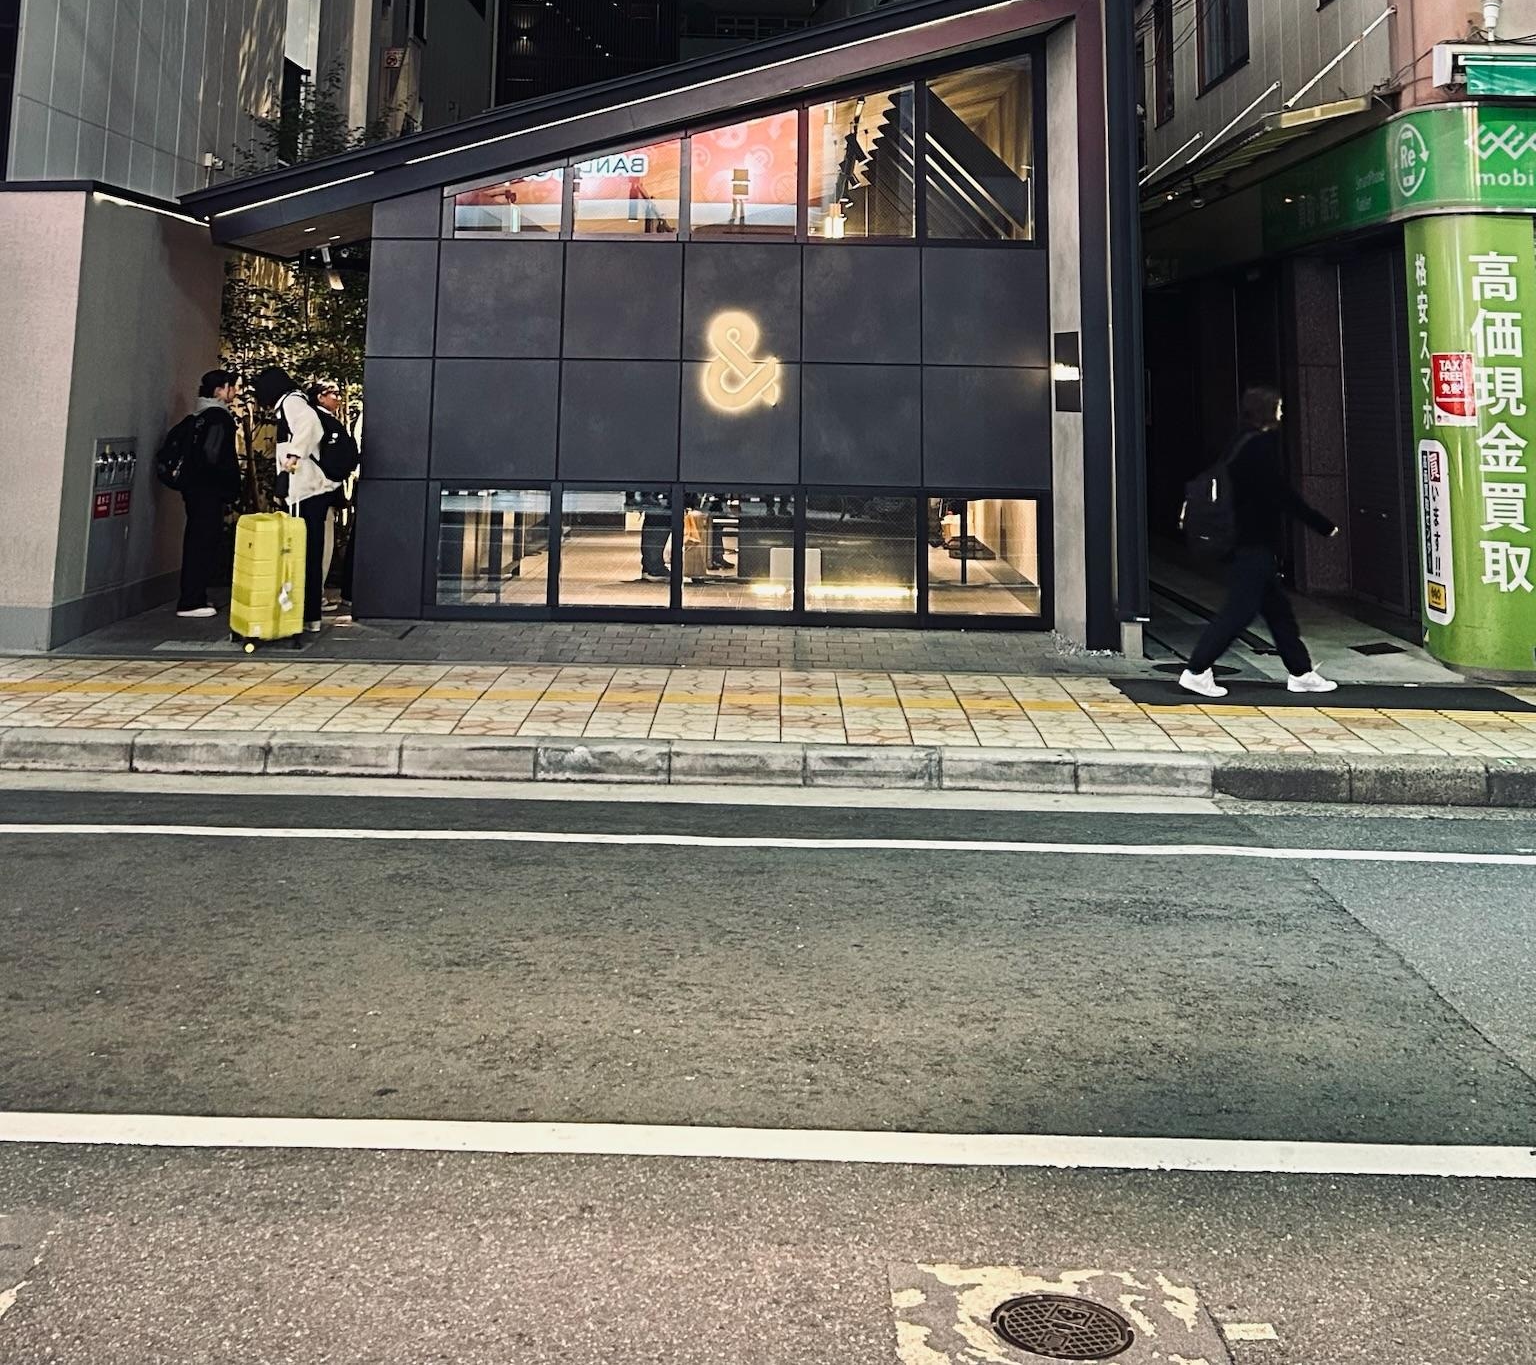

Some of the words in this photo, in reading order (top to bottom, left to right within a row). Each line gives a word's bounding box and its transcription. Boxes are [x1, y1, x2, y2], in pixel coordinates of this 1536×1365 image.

[1401, 145, 1416, 169] Re
[702, 311, 780, 410] &
[1415, 253, 1434, 430] 格安スマホ
[1439, 359, 1463, 371] TAX
[1439, 371, 1463, 382] FREE
[1469, 251, 1535, 594] 高価現金買取
